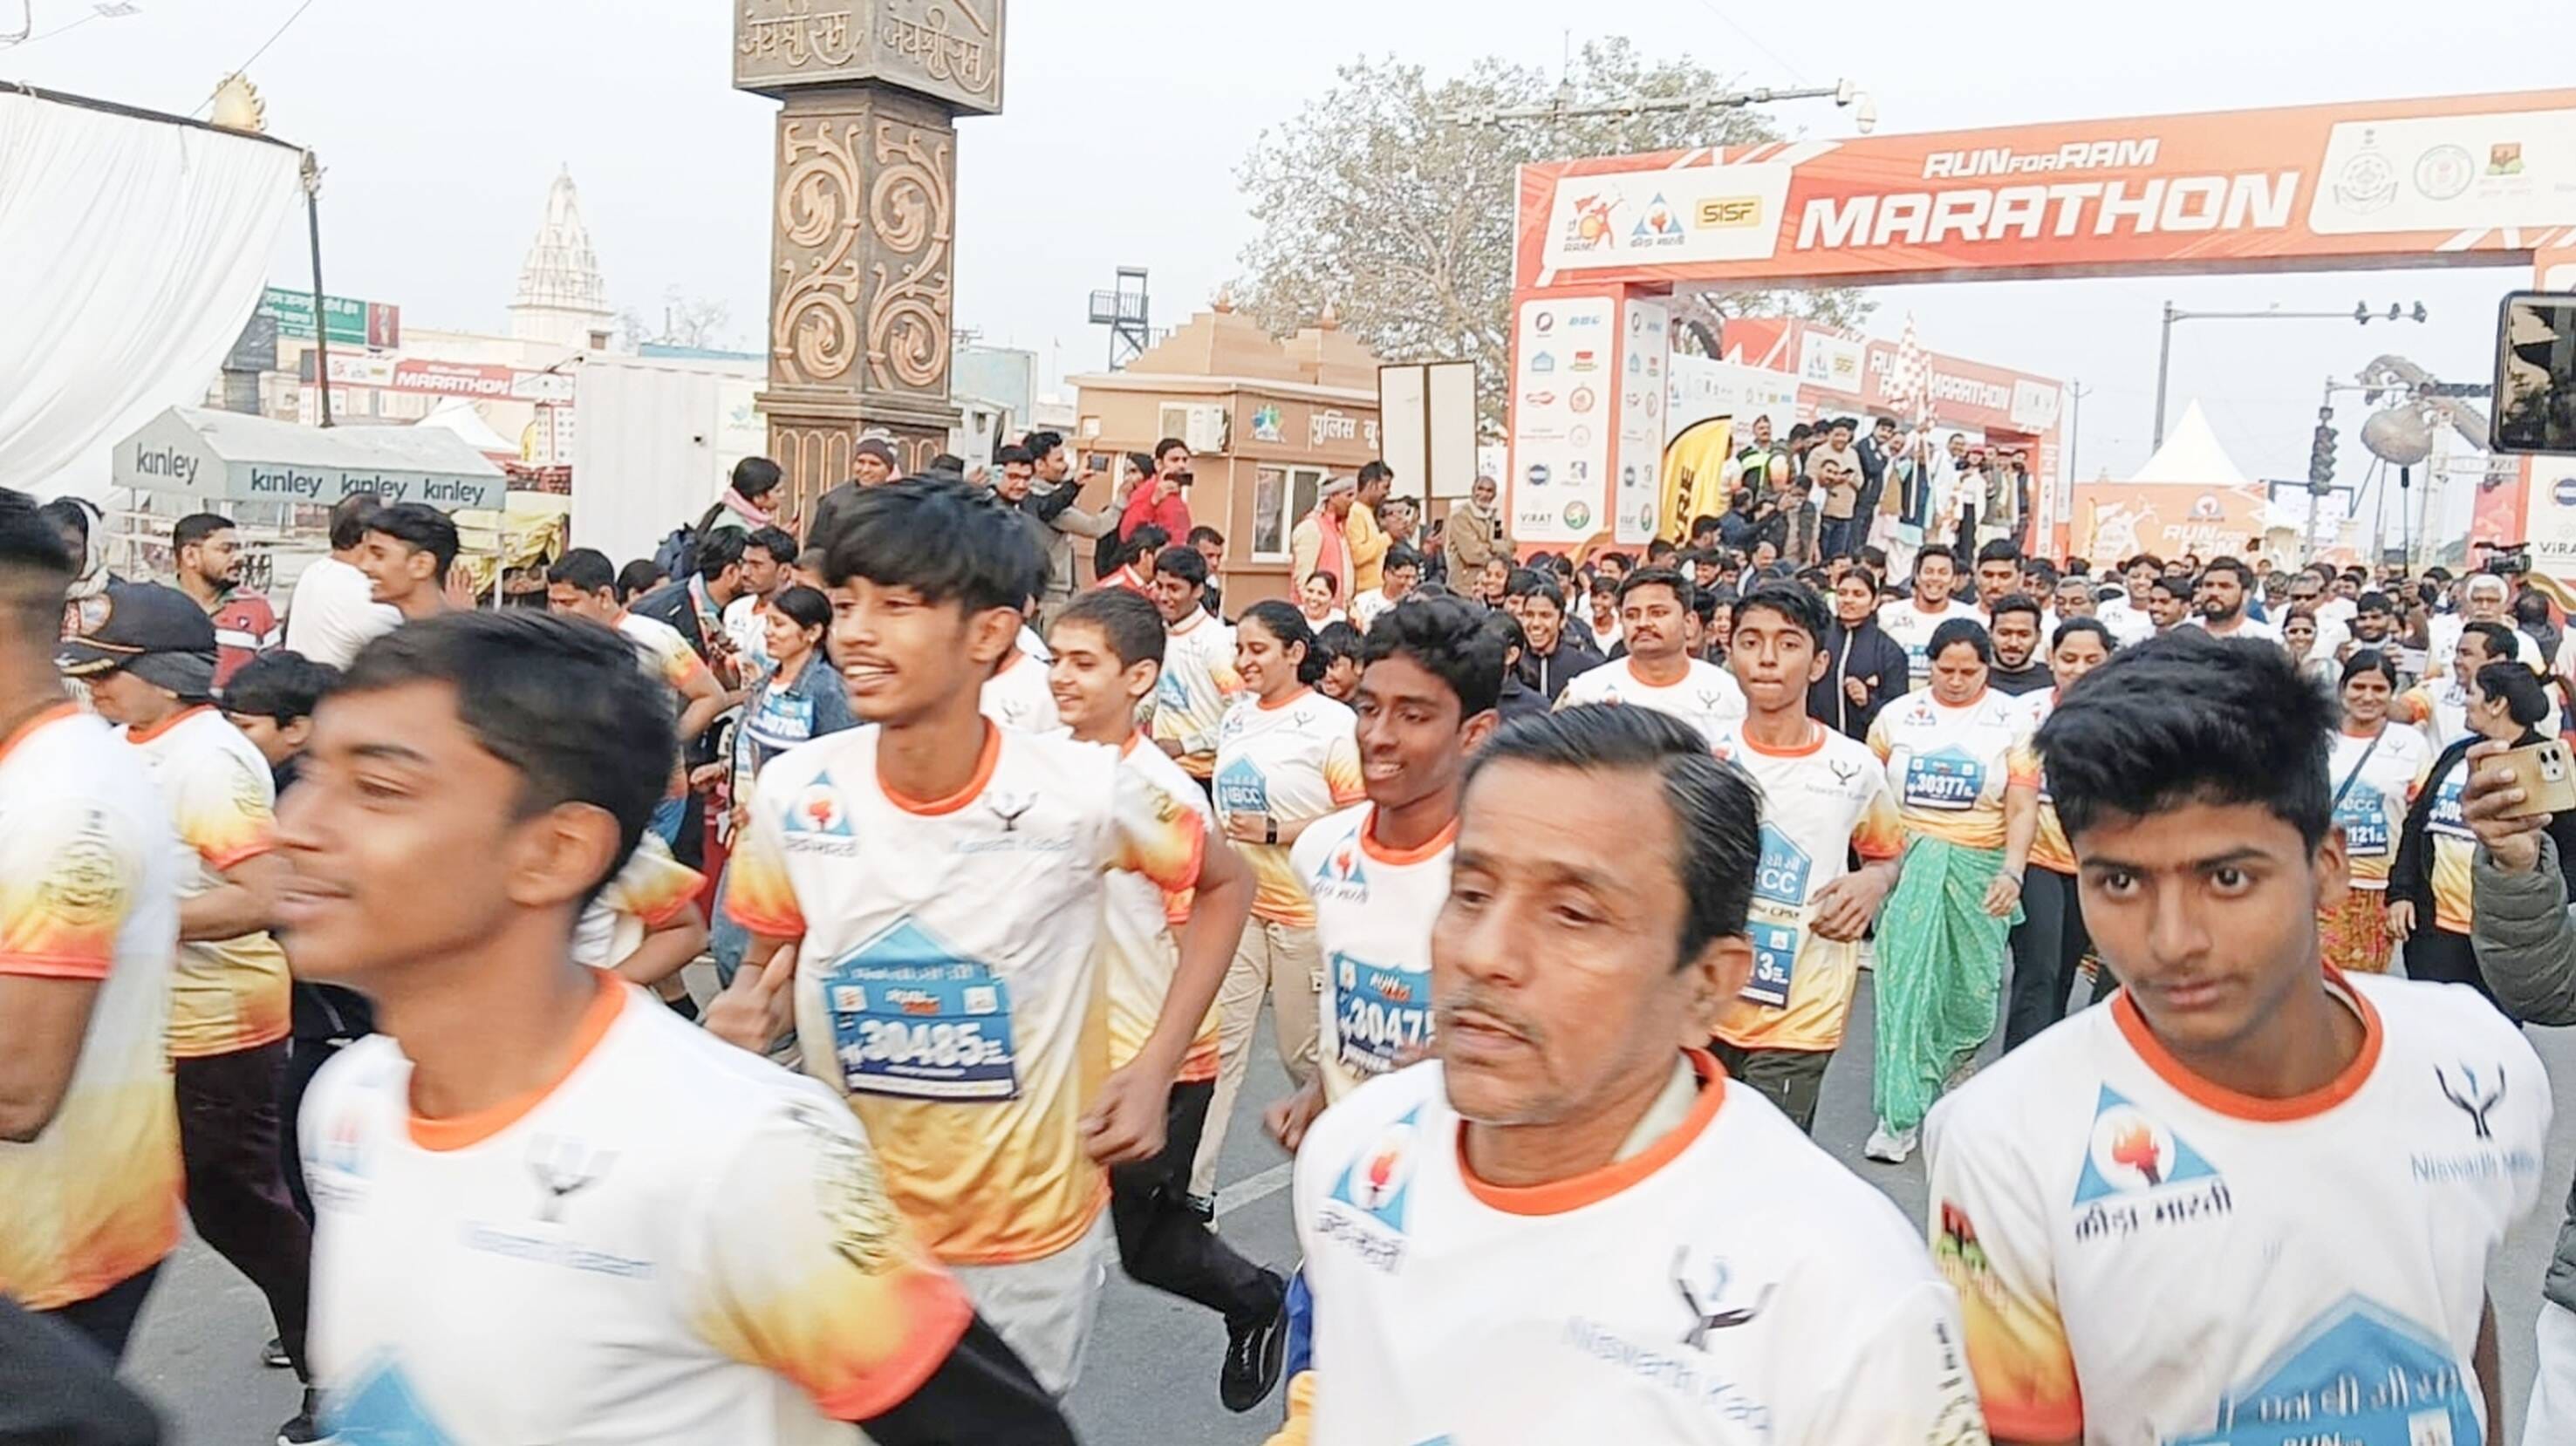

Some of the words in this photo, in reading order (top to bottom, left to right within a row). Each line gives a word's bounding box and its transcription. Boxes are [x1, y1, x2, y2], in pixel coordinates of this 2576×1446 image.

[1922, 147, 2011, 180] RUN
[2008, 153, 2059, 174] FOR
[2054, 138, 2160, 170] RAM
[1703, 201, 1755, 223] SISF
[1795, 170, 2301, 250] MARATHON
[397, 371, 509, 395] MARATHON
[1310, 409, 1357, 447] पुलिस
[136, 443, 199, 486] kinley
[251, 468, 324, 499] kinley
[423, 478, 486, 507] kinley
[2163, 524, 2219, 541] RUN
[1917, 773, 1965, 797] 30377
